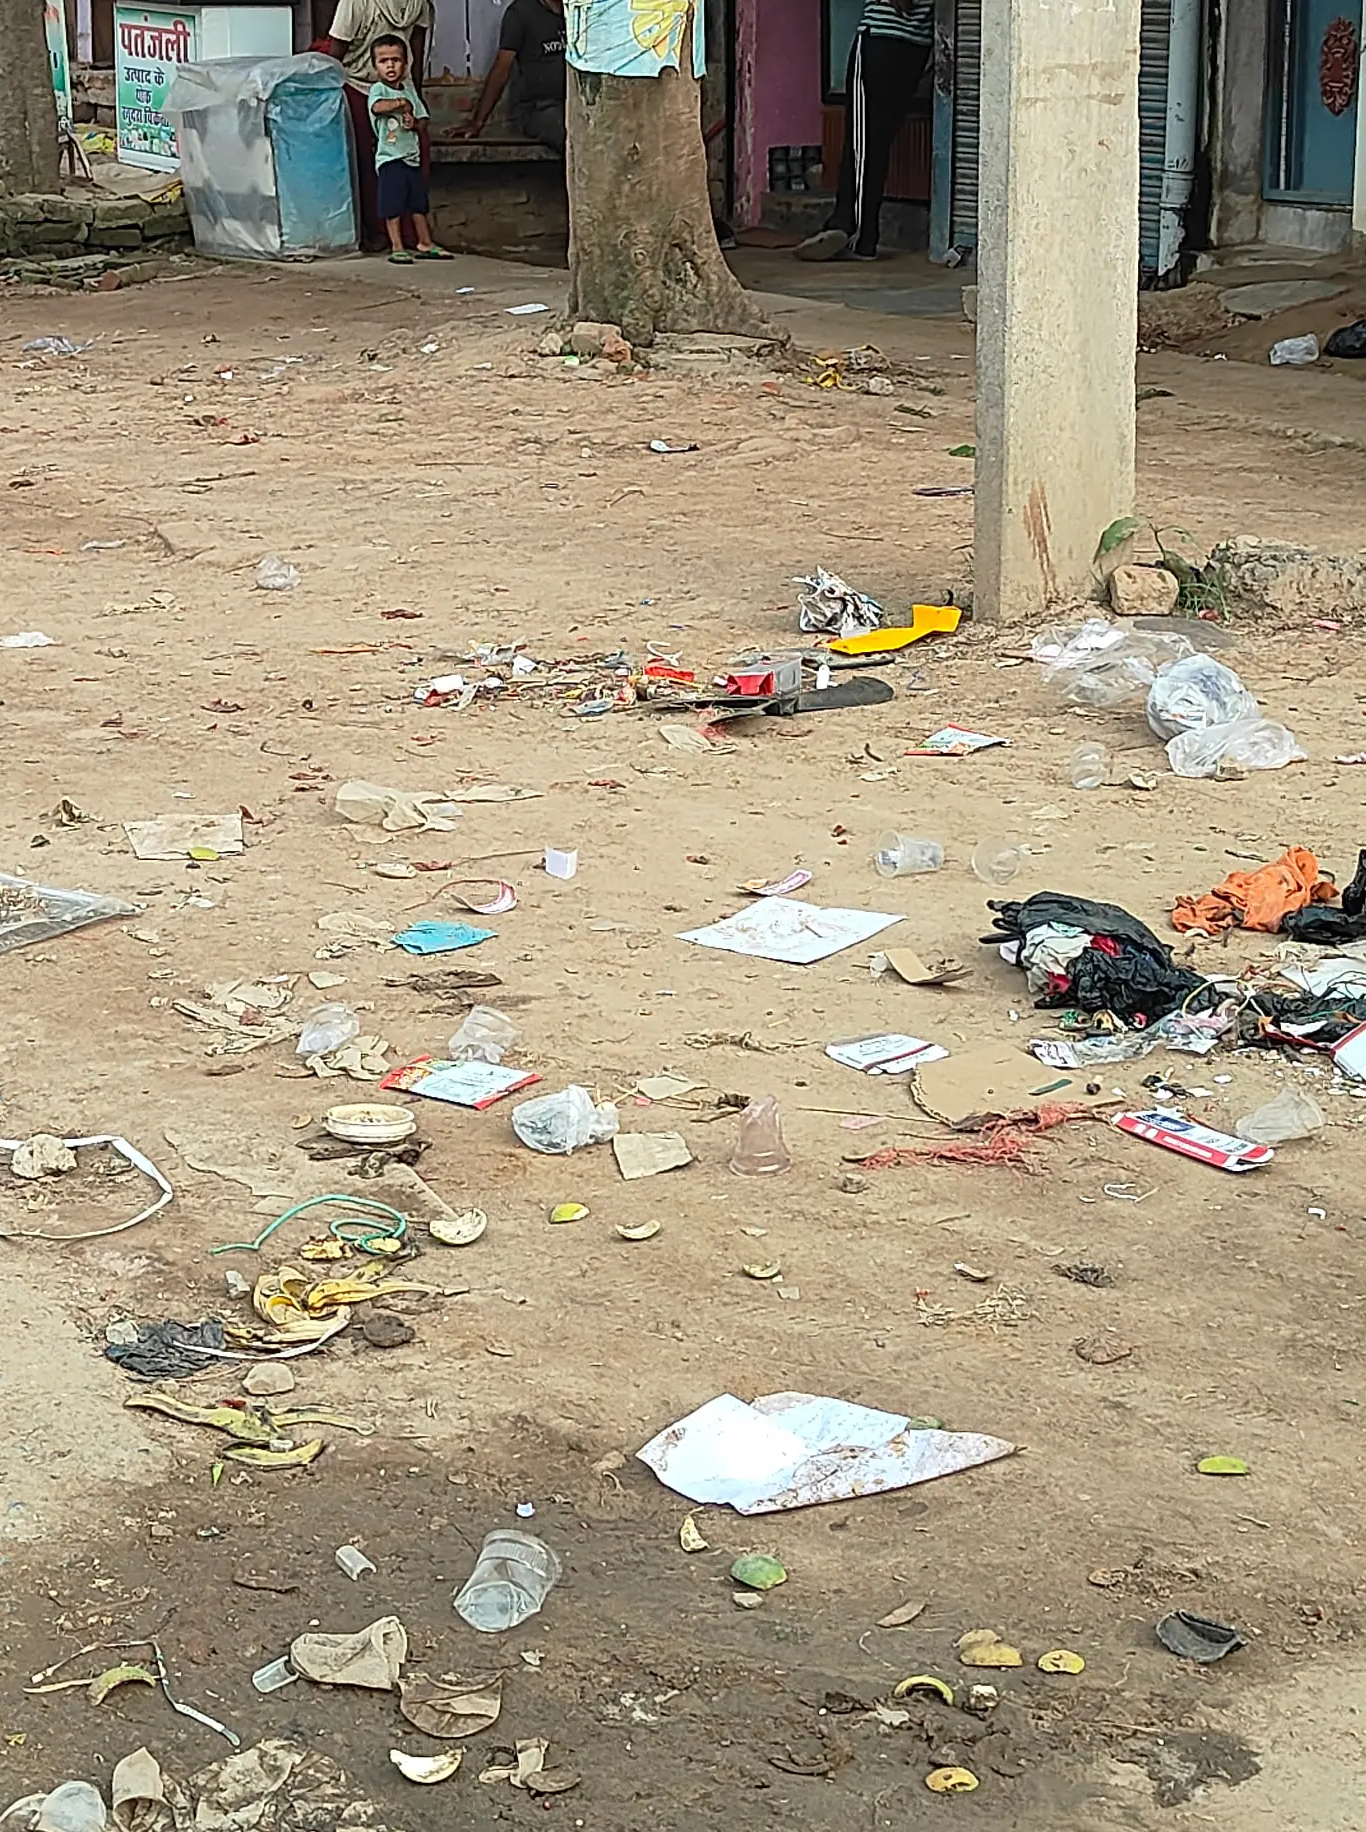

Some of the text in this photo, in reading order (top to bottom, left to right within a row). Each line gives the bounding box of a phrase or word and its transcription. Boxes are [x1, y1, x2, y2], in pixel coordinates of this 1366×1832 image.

[119, 15, 191, 64] पतंजली
[123, 66, 166, 86] उत्पाद के
